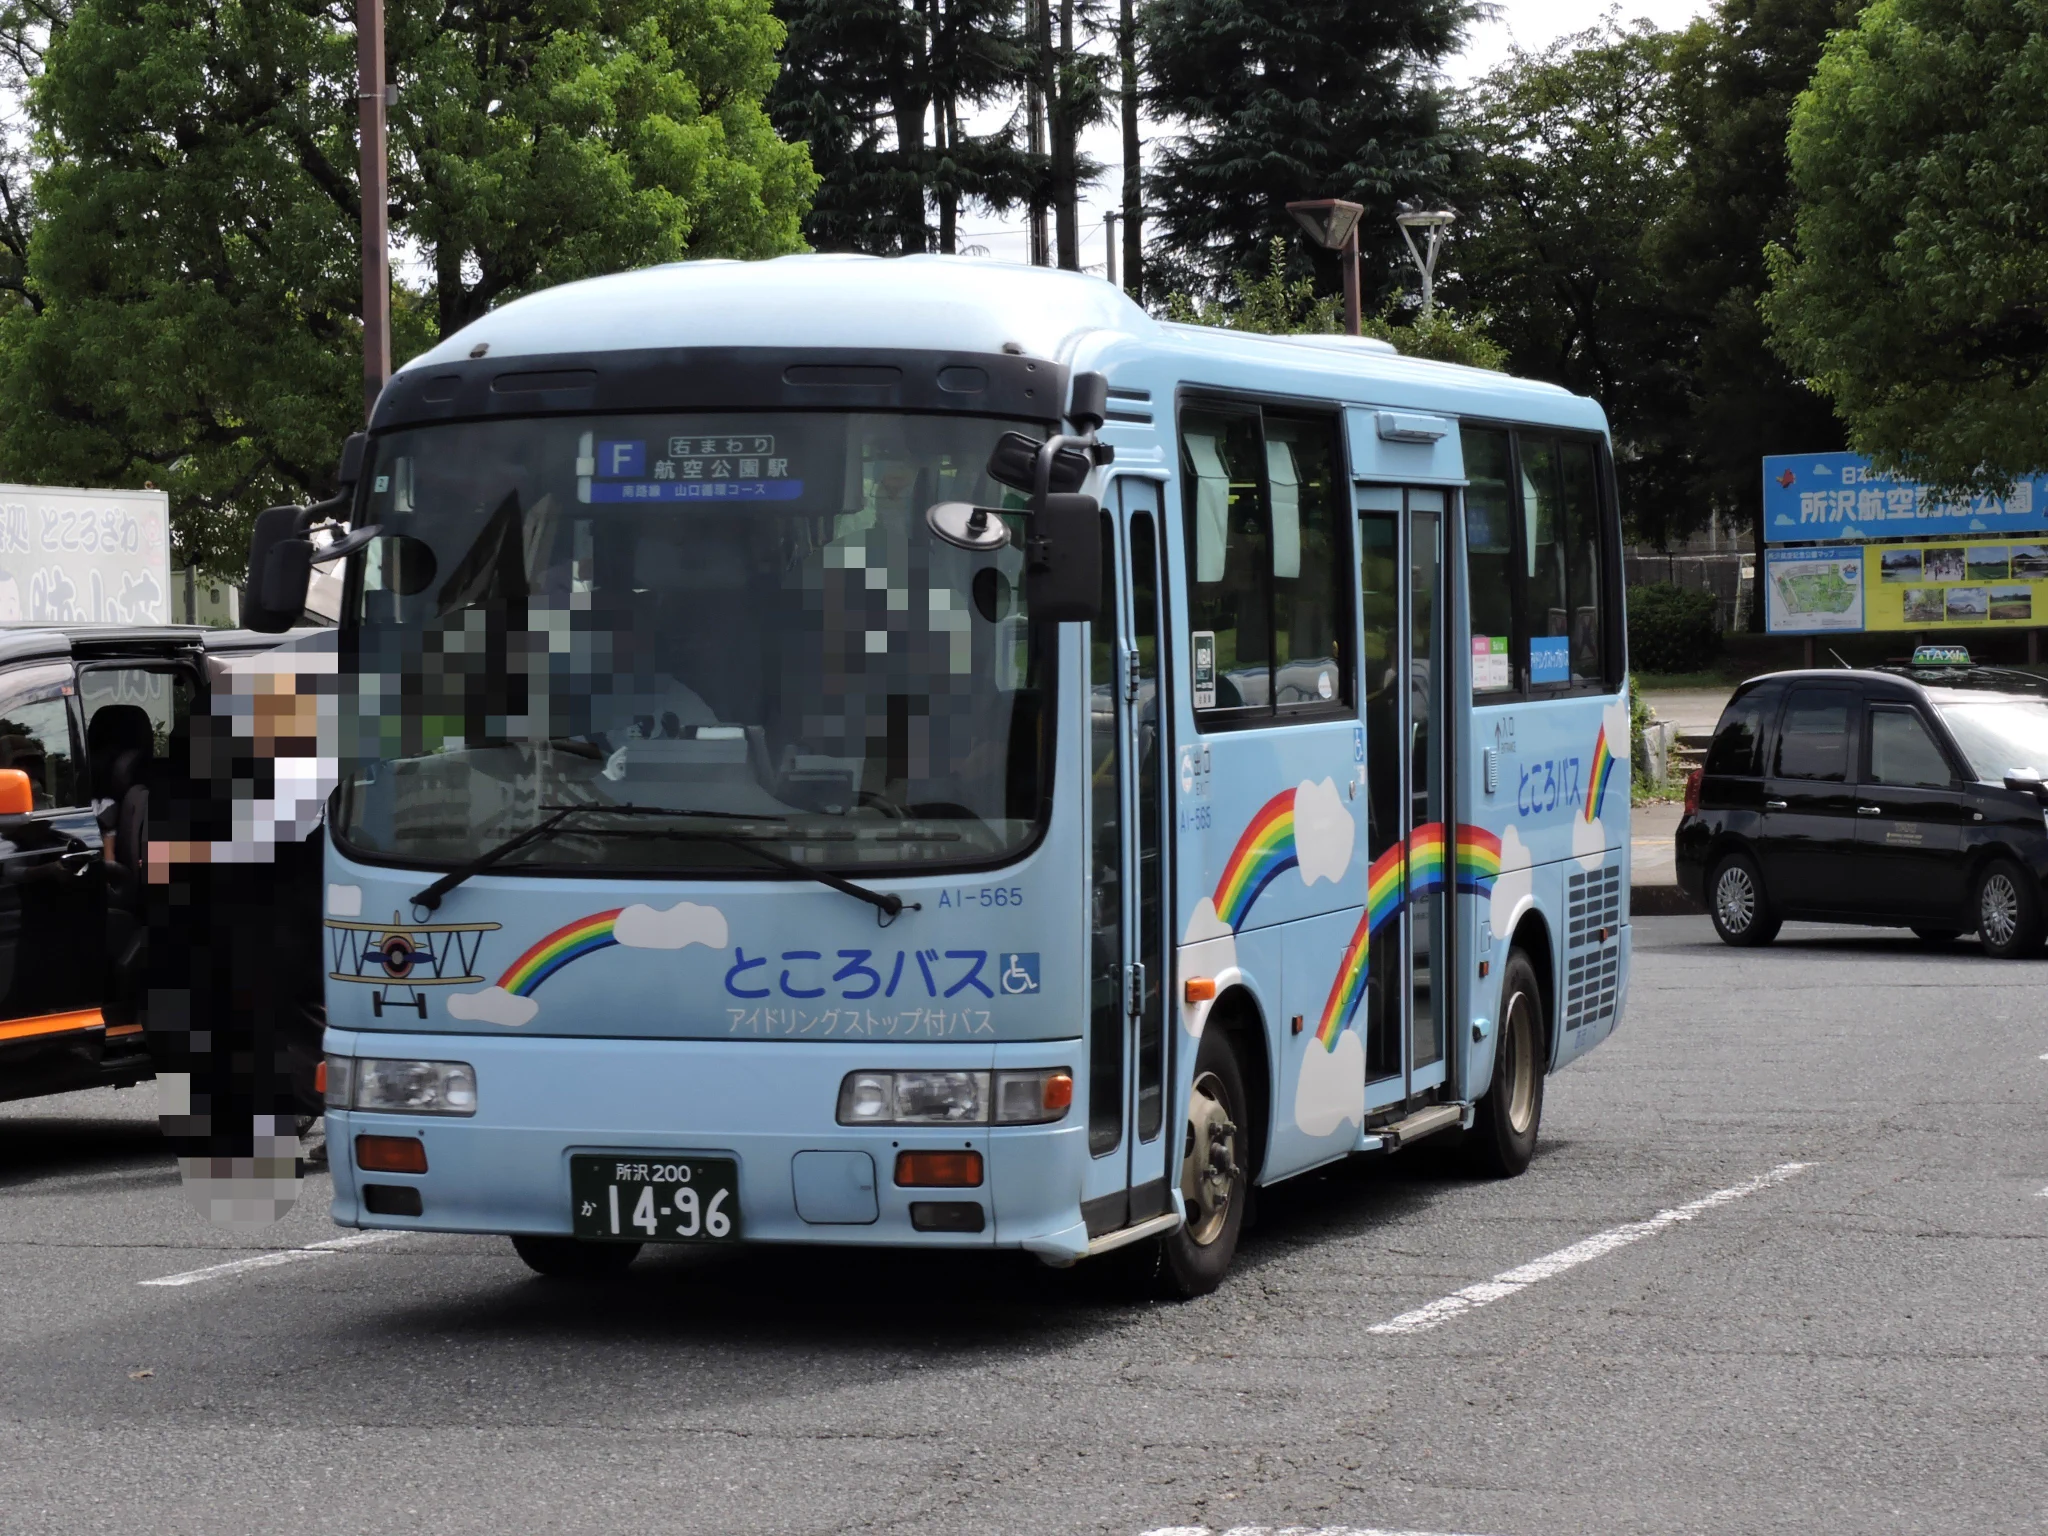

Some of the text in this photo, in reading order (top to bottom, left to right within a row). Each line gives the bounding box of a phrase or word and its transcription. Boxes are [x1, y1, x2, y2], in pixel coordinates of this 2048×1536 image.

[612, 444, 633, 474] F
[673, 438, 768, 455] 右まわり
[654, 458, 789, 480] 航空公園駅
[40, 506, 139, 553] ところざわ
[1922, 649, 1960, 661] TAXI
[1517, 757, 1581, 817] ところバス
[938, 887, 1023, 909] AI-565
[724, 947, 995, 1000] ところバス
[726, 1007, 995, 1036] アイドリングストップ付バス
[581, 1185, 731, 1238] か 14-96
